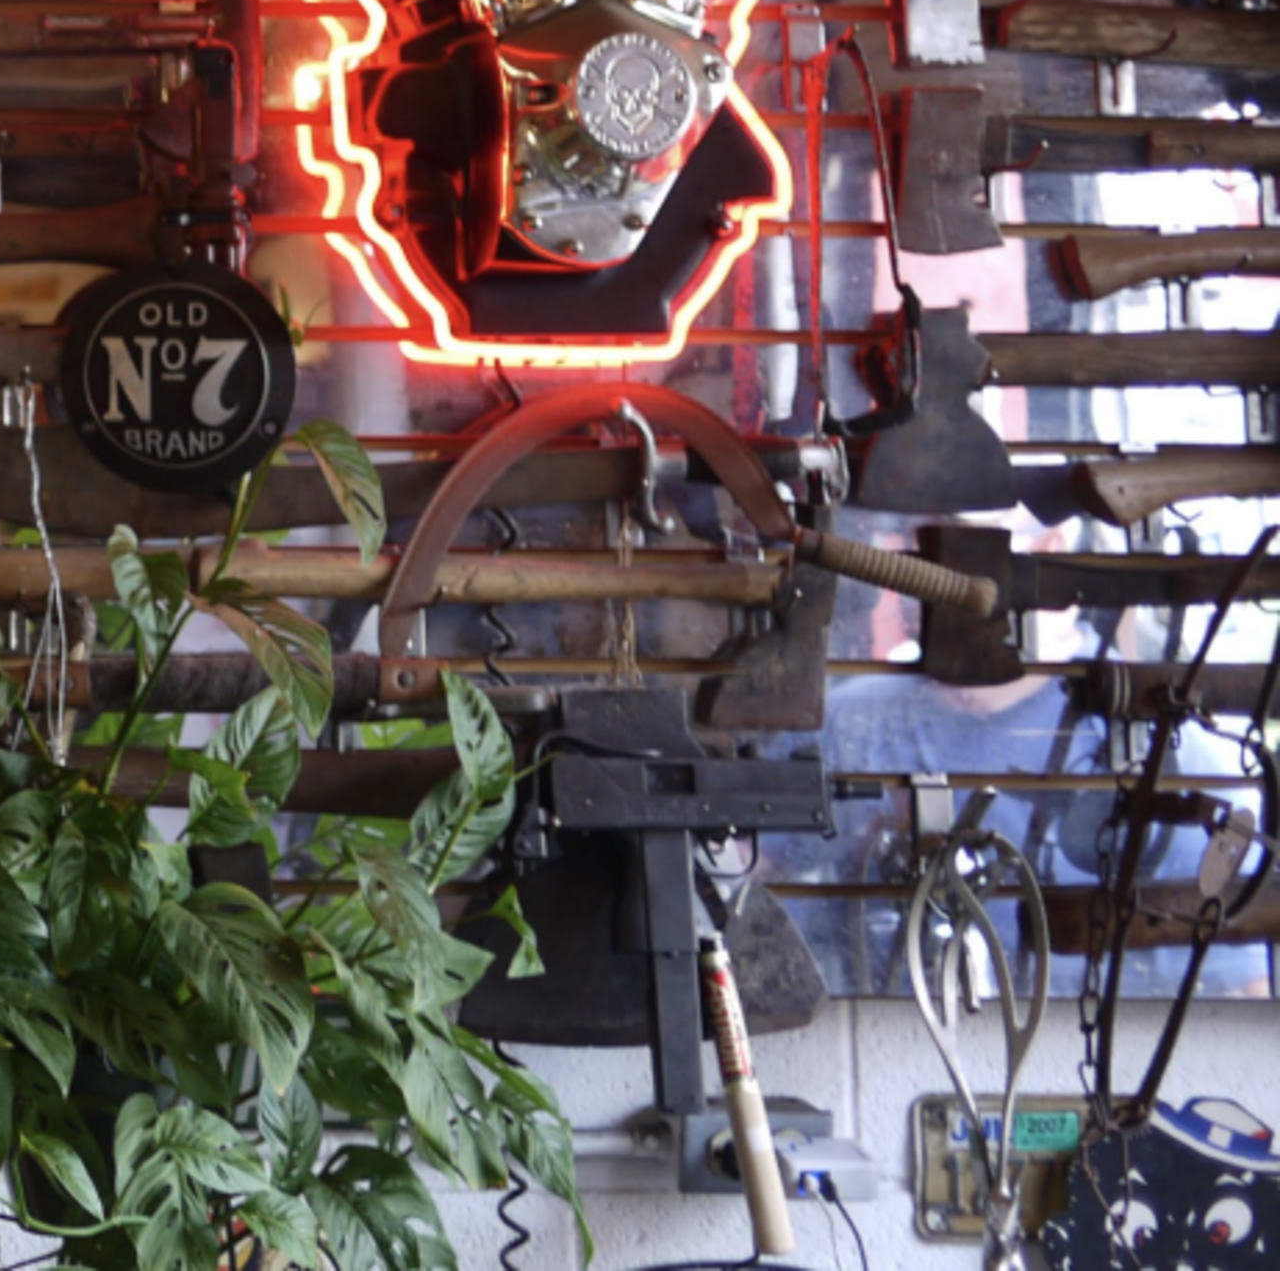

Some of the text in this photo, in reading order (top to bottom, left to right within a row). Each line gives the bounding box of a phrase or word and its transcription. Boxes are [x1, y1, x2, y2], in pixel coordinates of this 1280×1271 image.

[138, 302, 208, 327] OLD
[123, 429, 225, 460] BRAND
[1027, 1116, 1067, 1133] 2007
